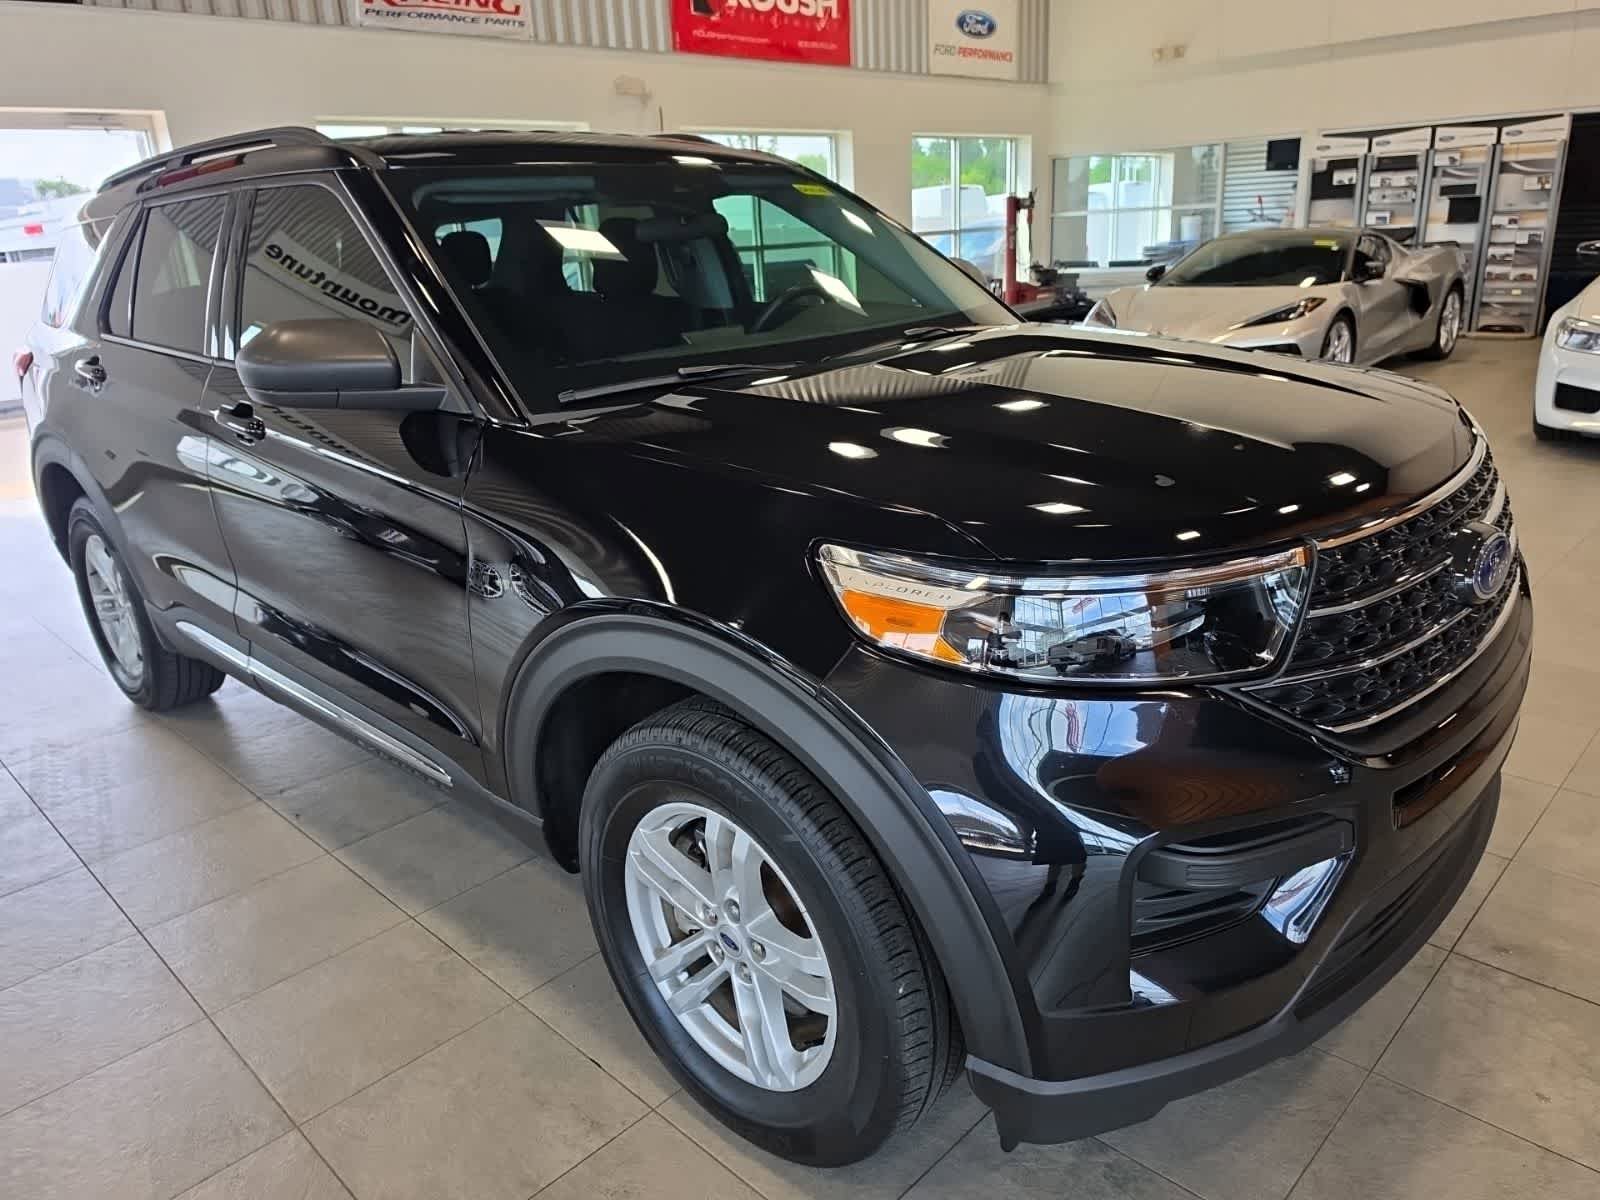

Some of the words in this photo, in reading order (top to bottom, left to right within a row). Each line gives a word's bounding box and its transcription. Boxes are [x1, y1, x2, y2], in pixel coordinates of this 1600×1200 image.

[365, 8, 480, 24] PERFORMANCE
[484, 17, 525, 28] PARTS
[964, 14, 990, 34] Ford
[934, 44, 956, 56] FORD
[848, 576, 951, 600] PLORER
